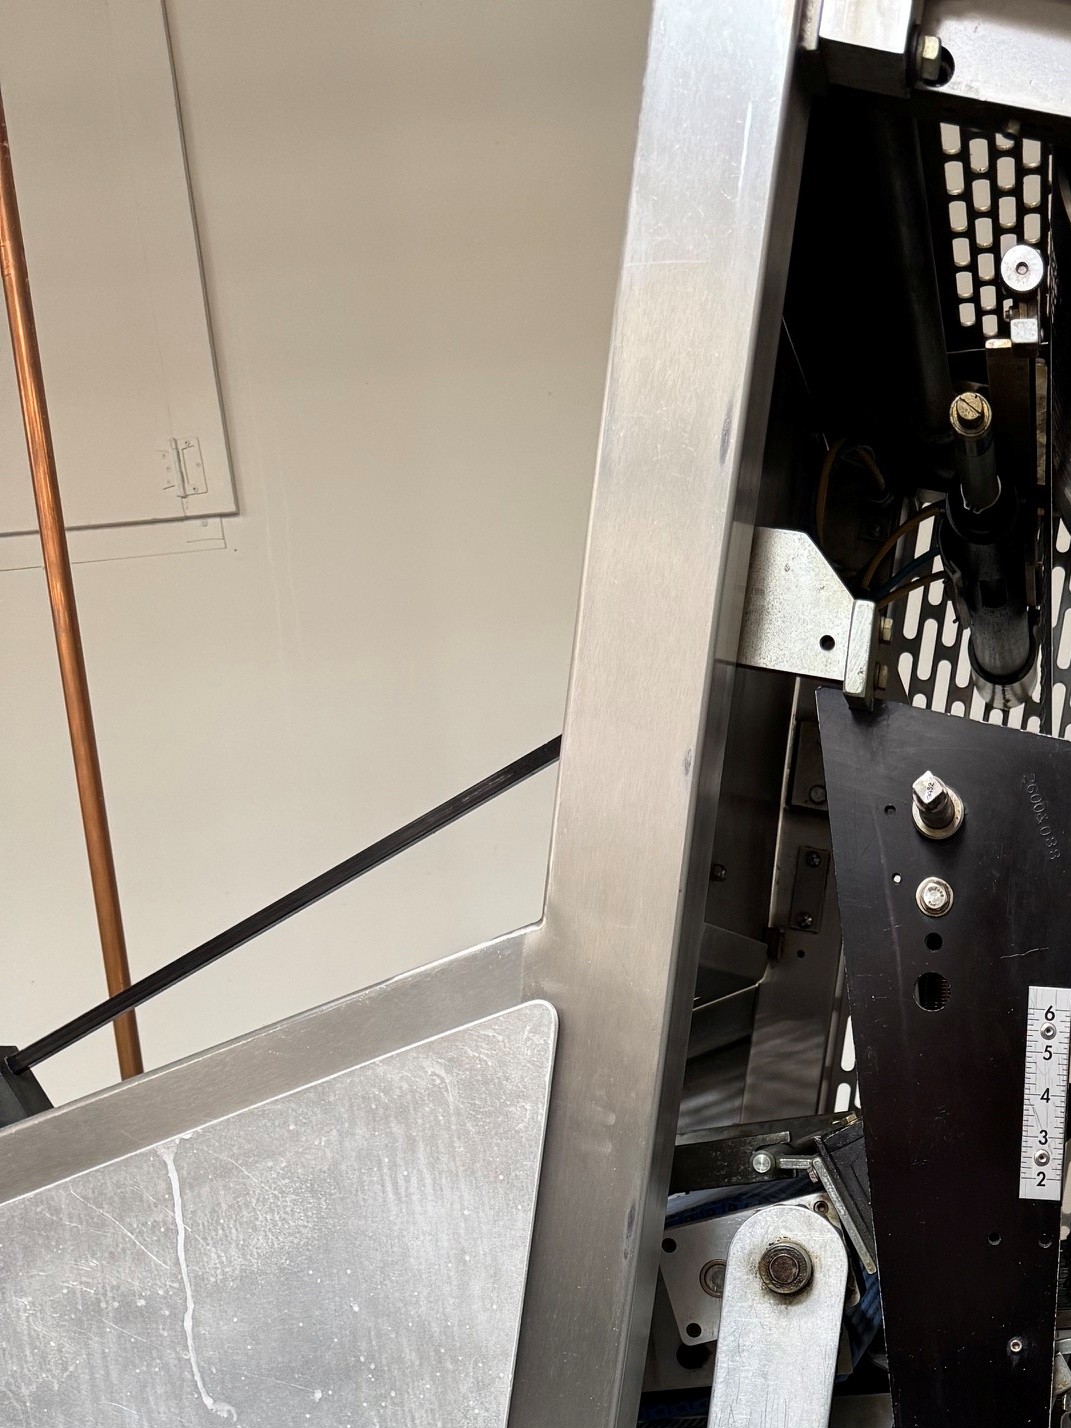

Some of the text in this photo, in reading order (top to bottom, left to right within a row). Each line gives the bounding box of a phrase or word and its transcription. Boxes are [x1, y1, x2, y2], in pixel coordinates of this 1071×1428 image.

[1044, 1005, 1056, 1022] 6
[1043, 1045, 1053, 1061] 5
[1040, 1088, 1051, 1104] 4
[1038, 1129, 1048, 1145] 3
[1036, 1171, 1046, 1187] 2
